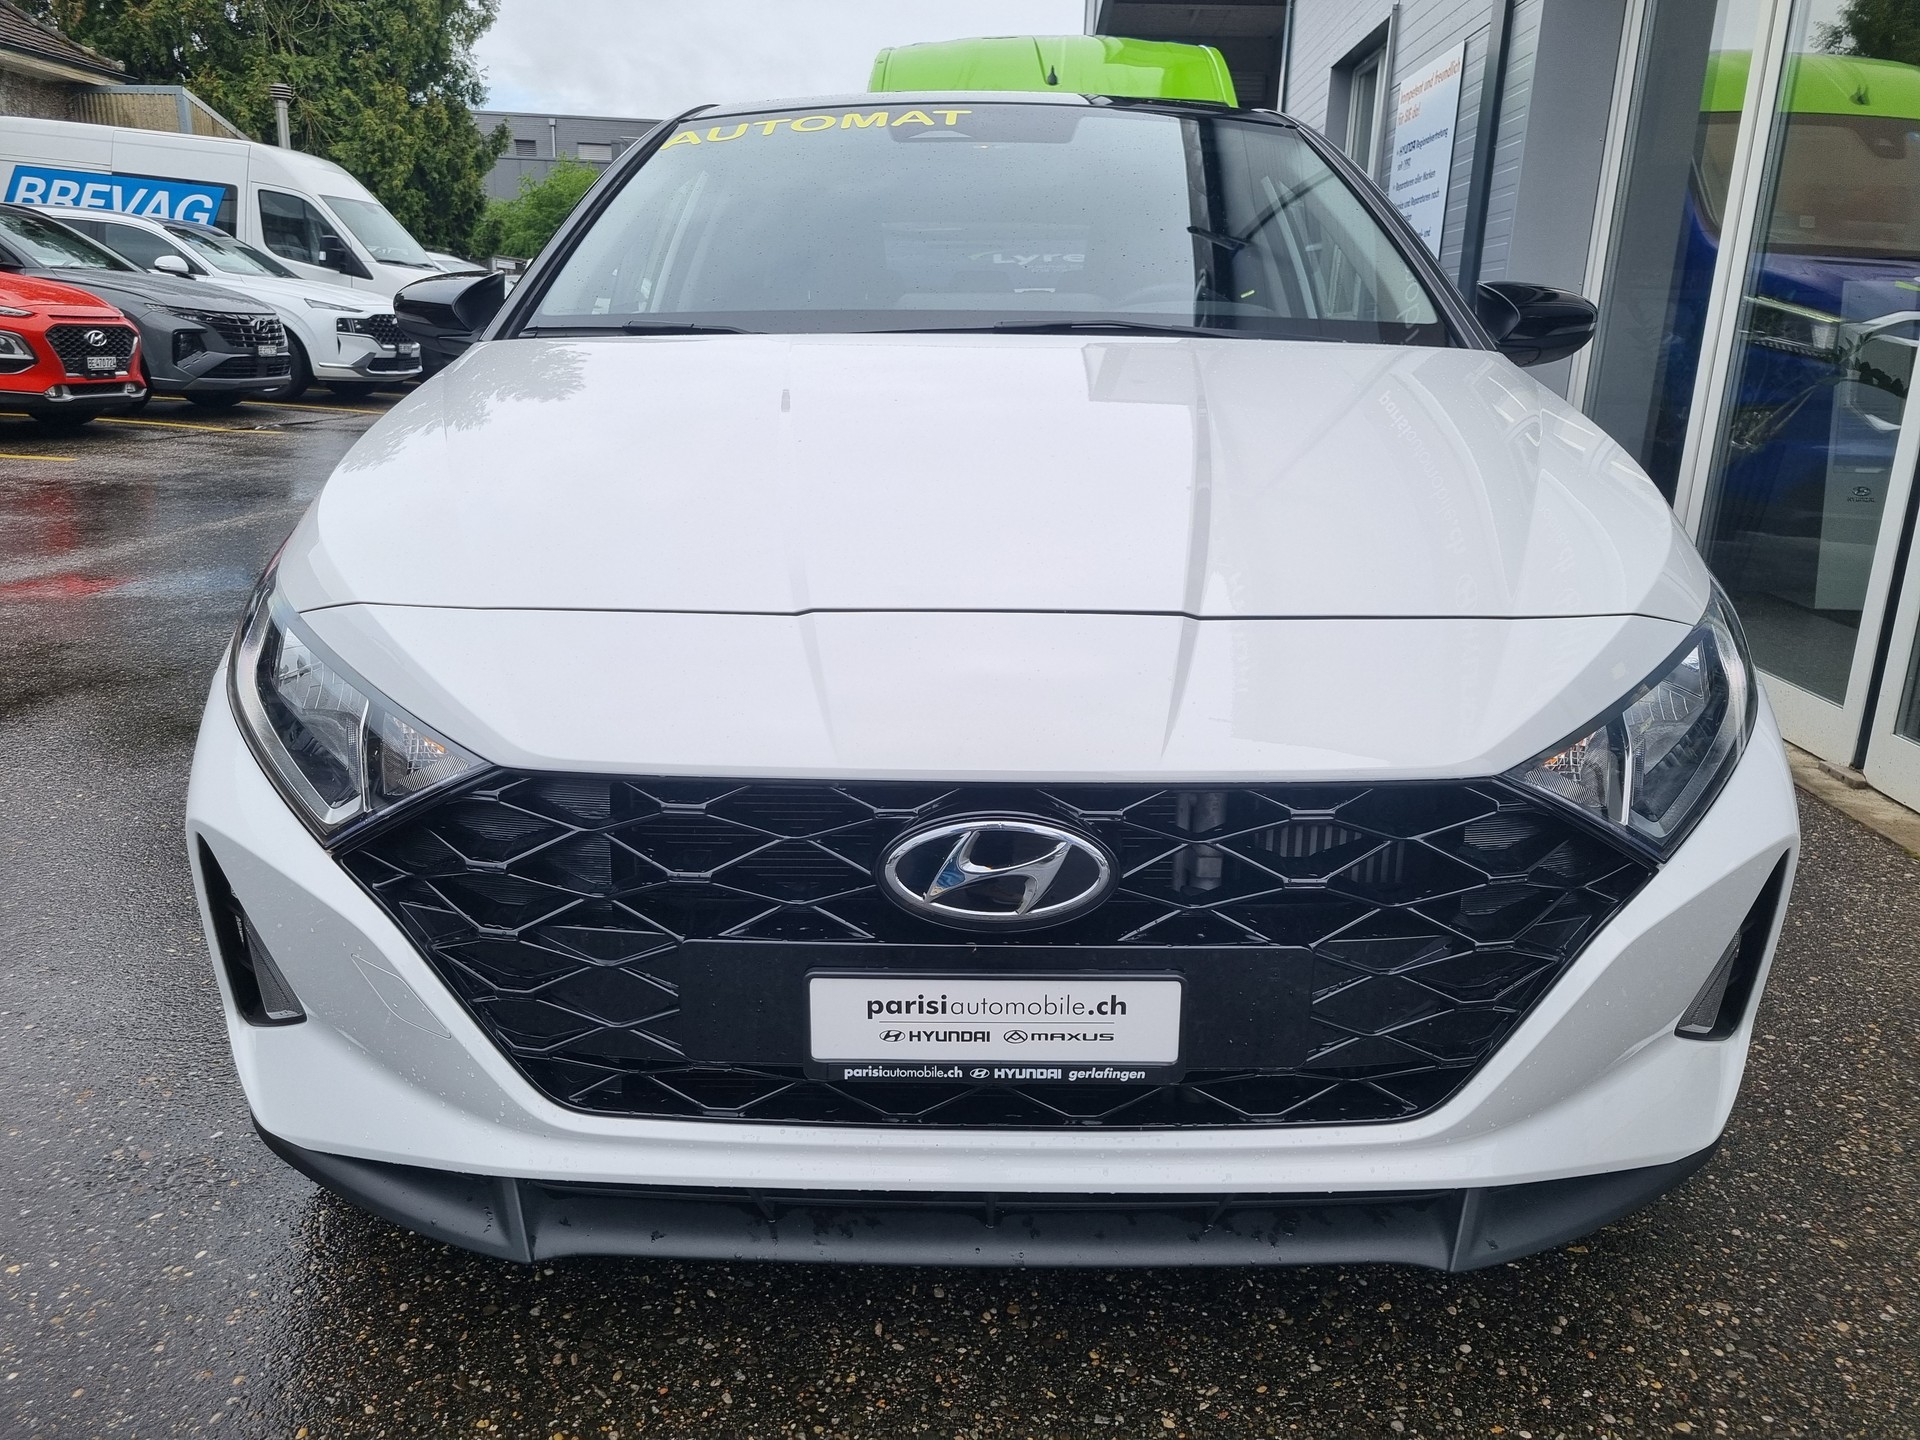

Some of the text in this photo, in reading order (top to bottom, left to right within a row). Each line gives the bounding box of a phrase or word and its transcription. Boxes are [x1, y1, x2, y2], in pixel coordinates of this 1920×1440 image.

[660, 110, 972, 150] AUTOMAT
[867, 994, 1126, 1020] parisiautomobile.ch
[909, 1030, 1115, 1042] HYUNDAI MAXUS
[844, 1065, 1146, 1082] parisiautomobile.ch HYUNDAI gerlafingen
